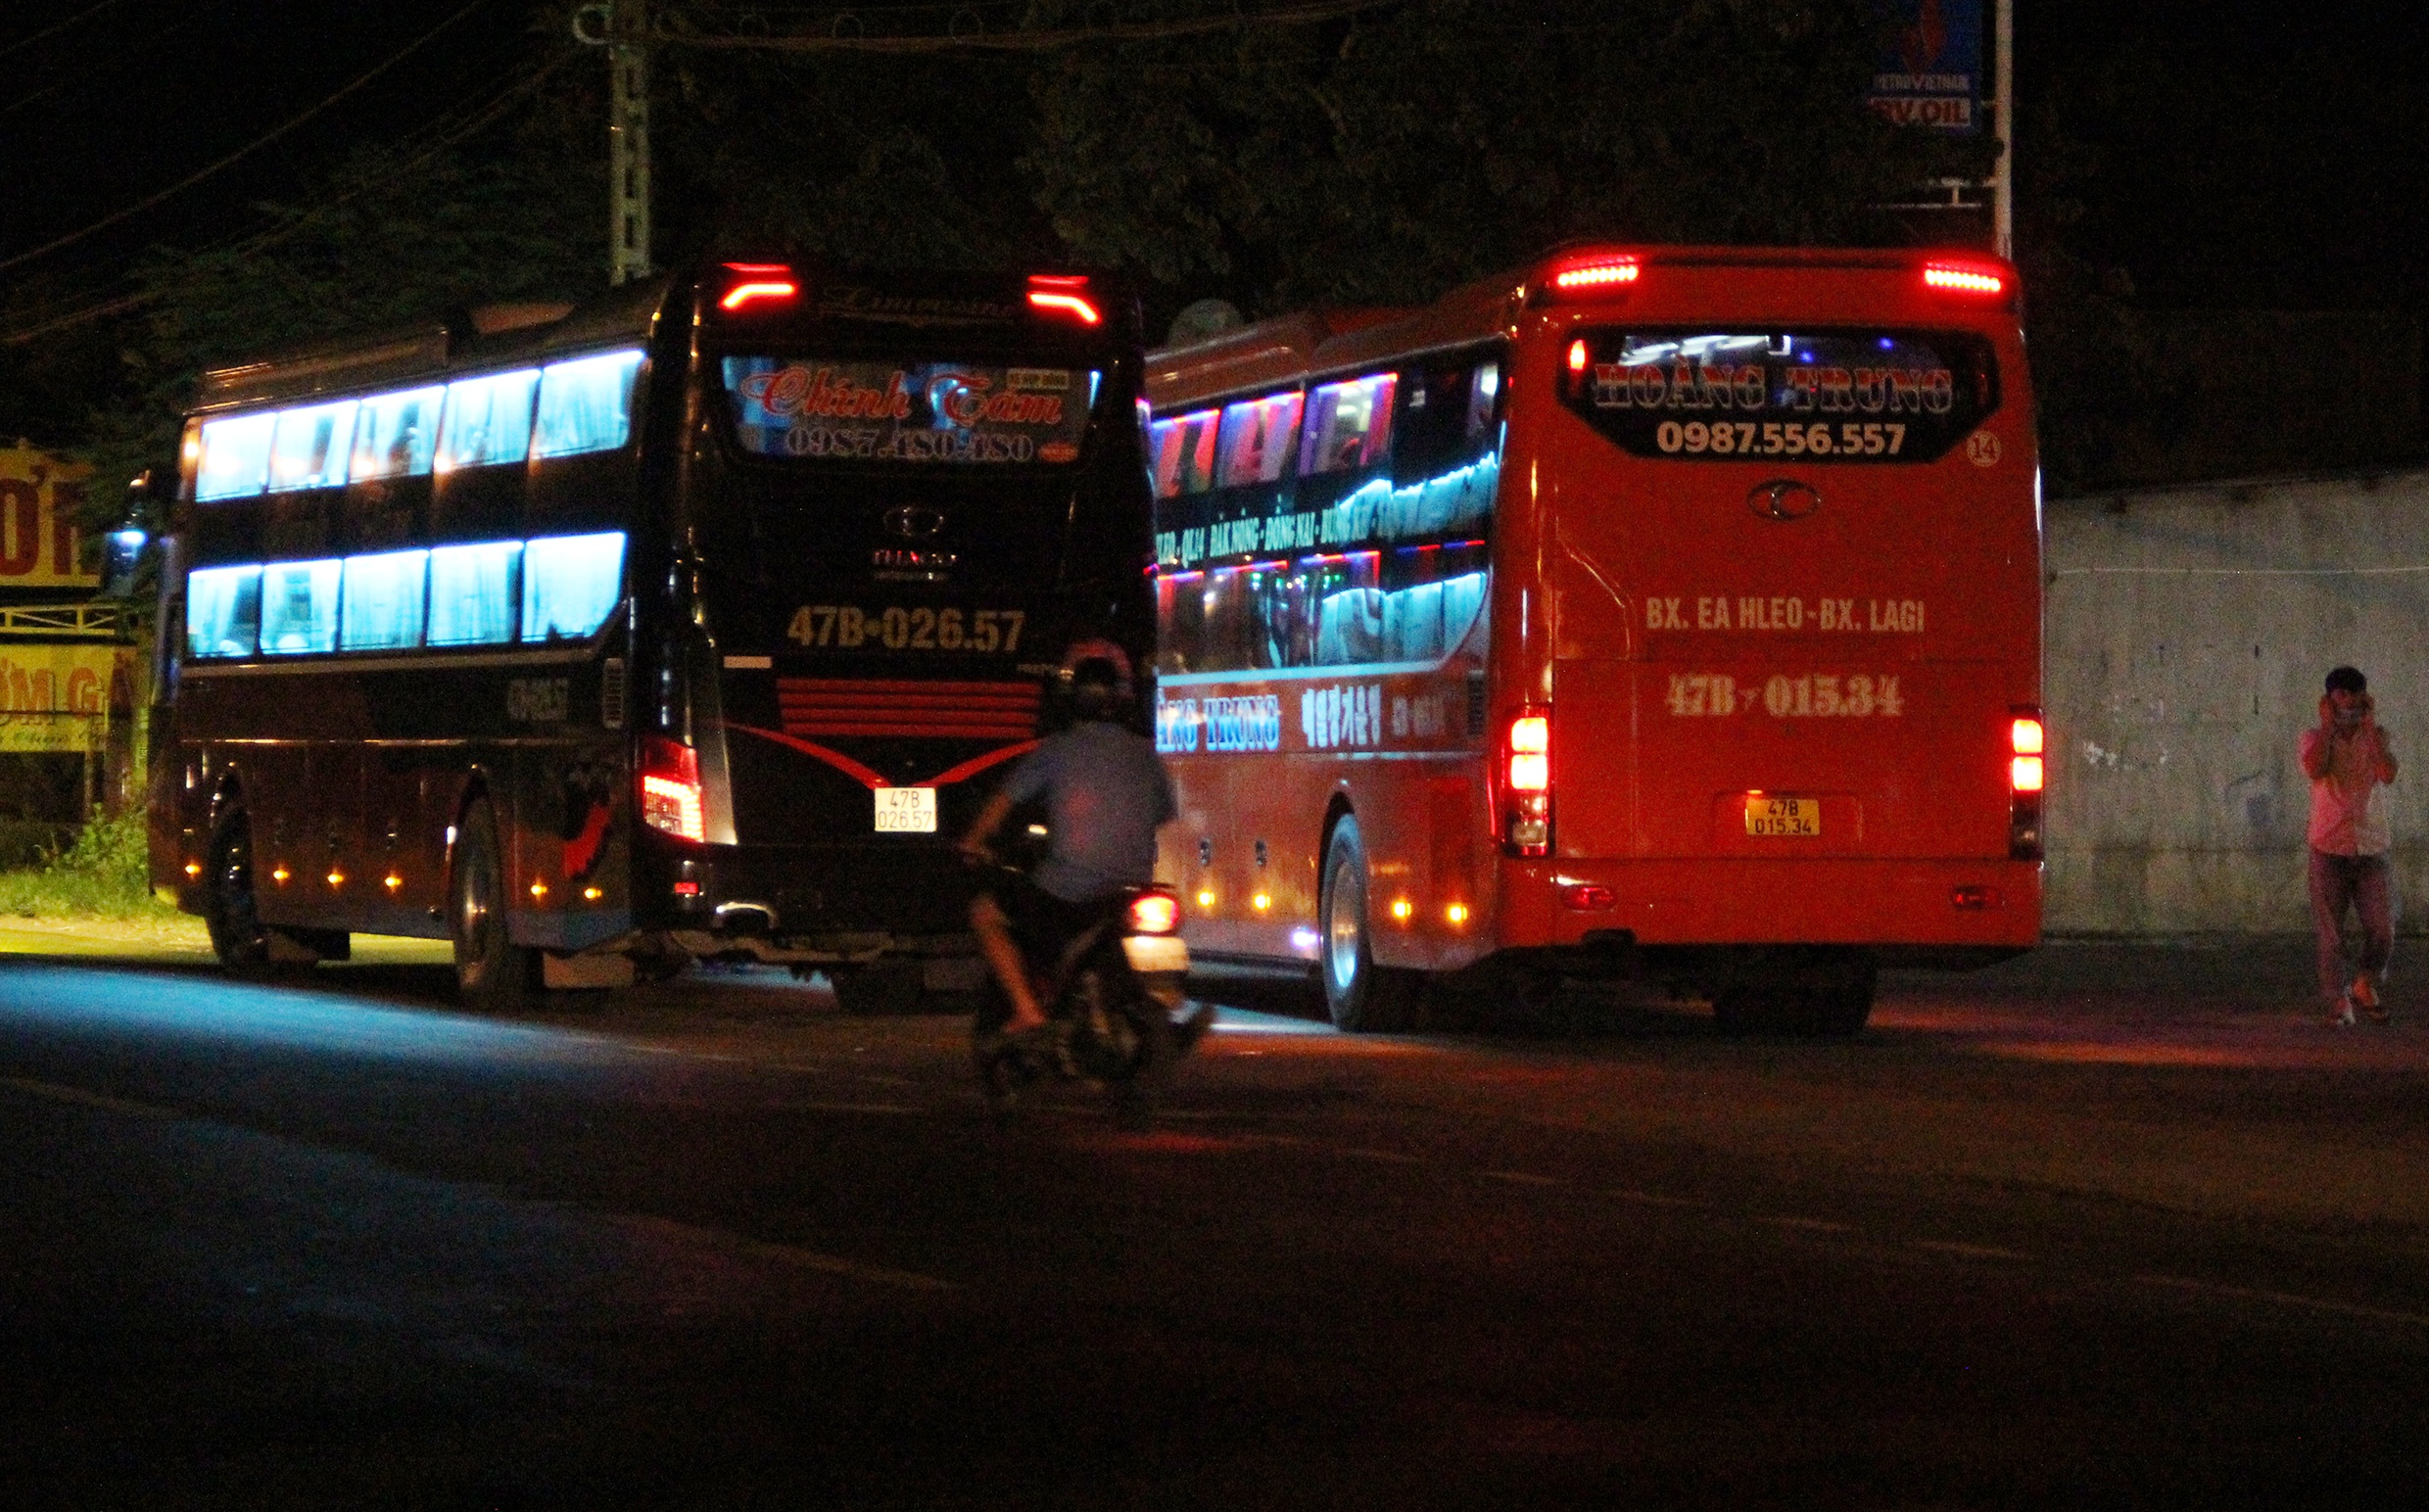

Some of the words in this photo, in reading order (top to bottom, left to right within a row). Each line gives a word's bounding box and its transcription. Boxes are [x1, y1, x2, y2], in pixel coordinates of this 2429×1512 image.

[1921, 100, 1970, 123] OIL
[1786, 366, 1953, 414] TRUNG
[1656, 420, 1906, 455] 0987.556.557
[1973, 437, 1996, 460] 14
[1645, 596, 1690, 631] BX.
[1696, 596, 1732, 630] EA
[1869, 598, 1926, 633] LAGI
[889, 789, 920, 808] 47B
[1767, 799, 1799, 817] 47B
[1754, 818, 1812, 834] 015.34
